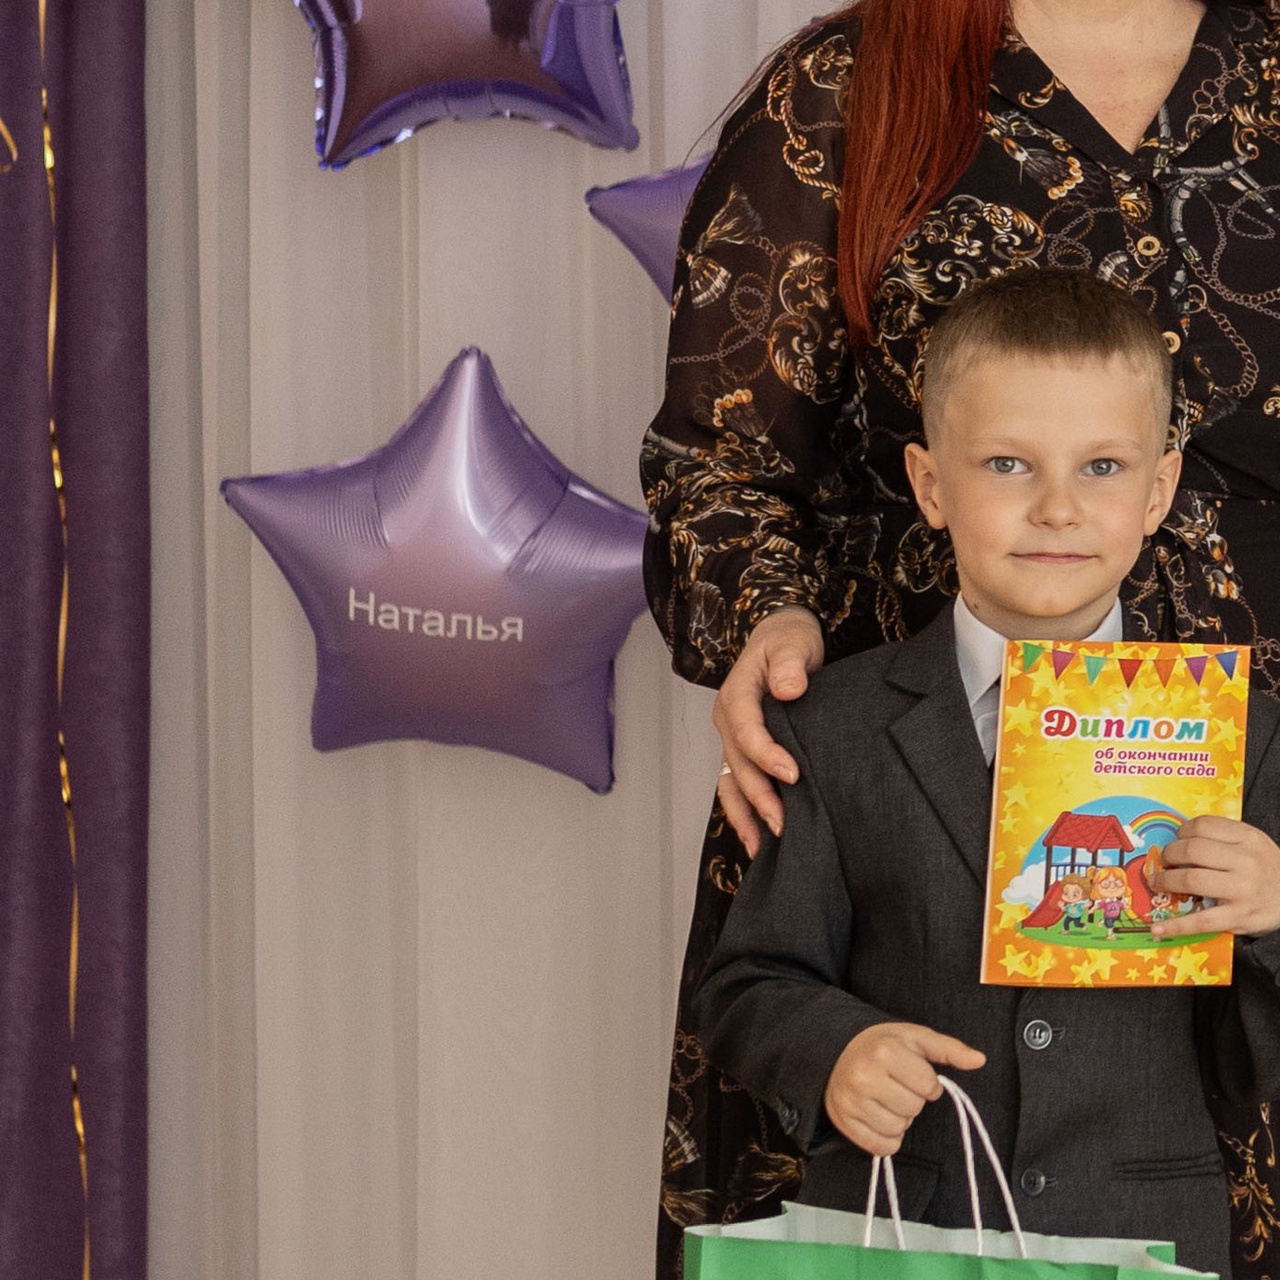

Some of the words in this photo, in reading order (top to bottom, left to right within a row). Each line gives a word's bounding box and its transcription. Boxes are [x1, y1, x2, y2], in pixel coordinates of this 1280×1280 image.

[347, 587, 525, 642] Наталья
[1043, 708, 1206, 741] Диплом
[1094, 747, 1114, 760] об
[1117, 749, 1210, 762] окончании
[1093, 761, 1174, 776] детского
[1177, 763, 1216, 777] сада
